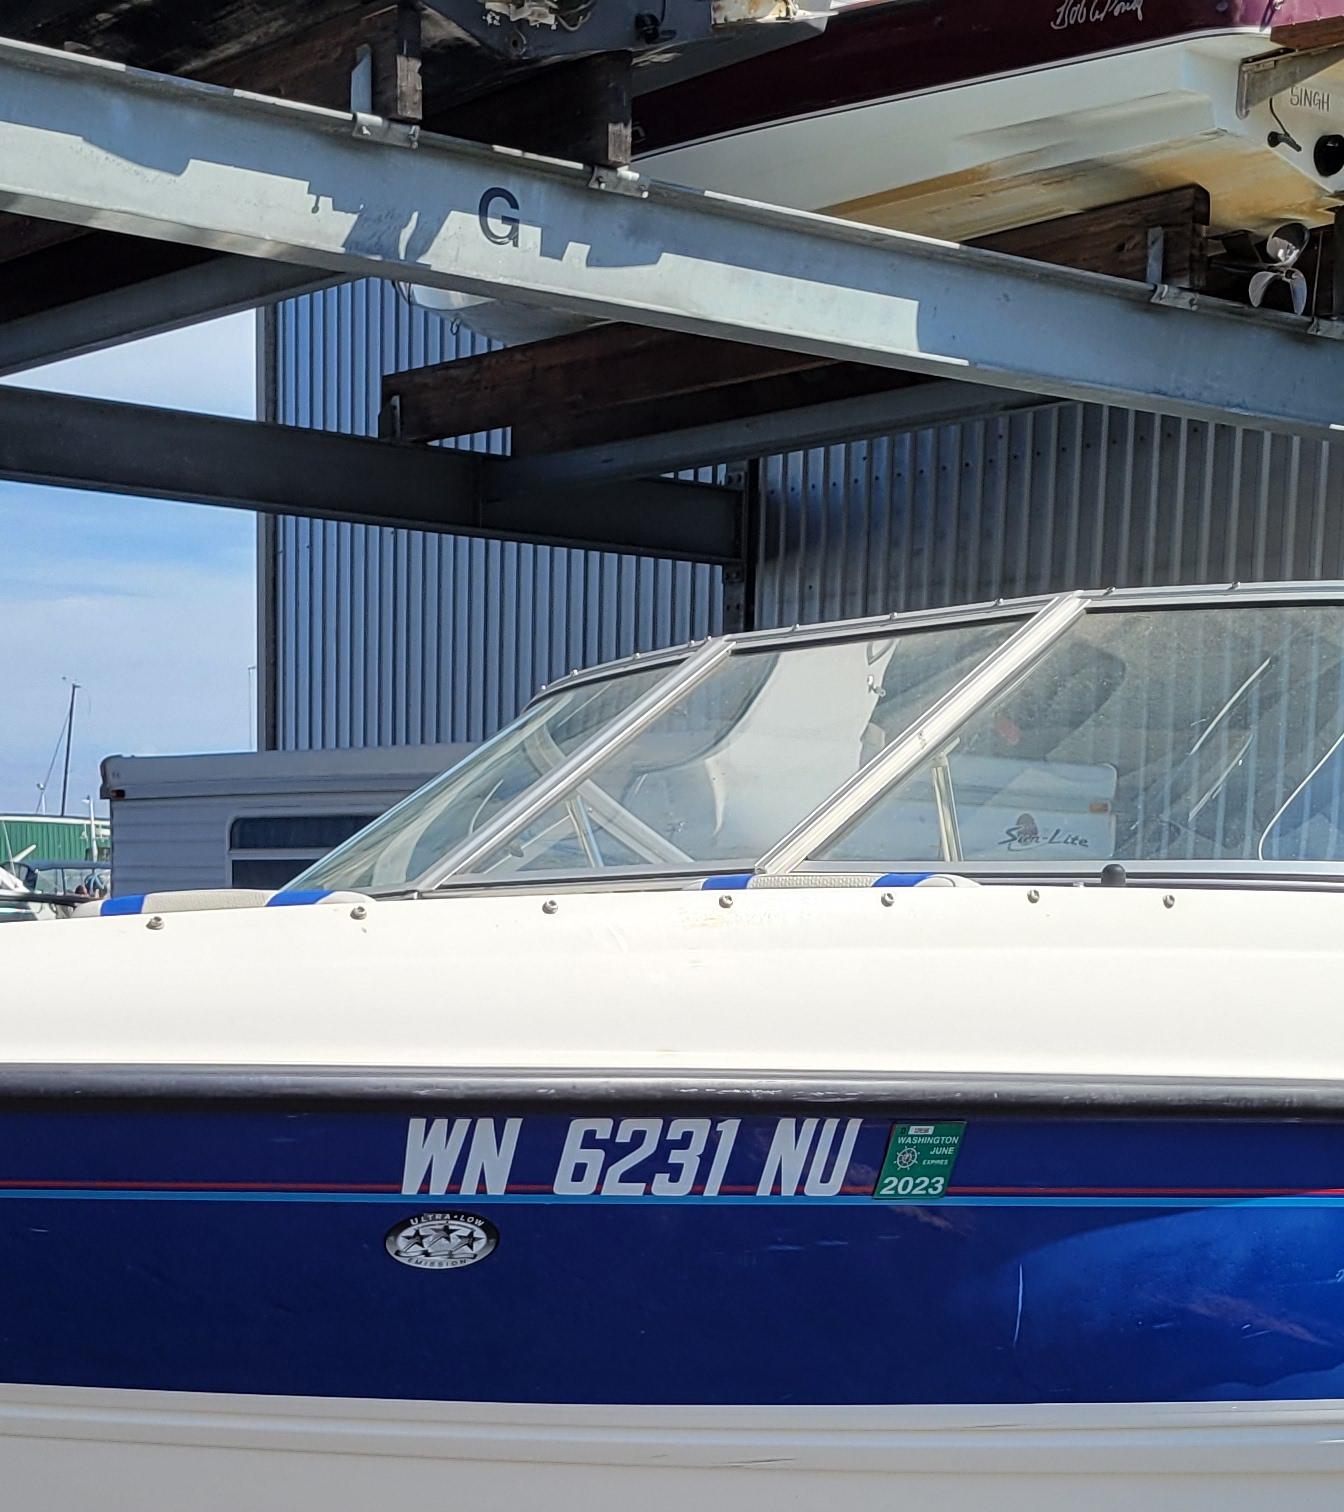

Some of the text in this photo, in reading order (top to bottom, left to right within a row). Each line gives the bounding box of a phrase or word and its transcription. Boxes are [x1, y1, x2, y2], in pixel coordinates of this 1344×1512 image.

[1290, 87, 1330, 112] SINGH
[478, 187, 520, 248] G
[897, 1136, 959, 1144] WASHINGTON
[930, 1146, 955, 1155] JUNE
[402, 1118, 863, 1197] WN 6231 NU
[880, 1176, 945, 1195] 2023
